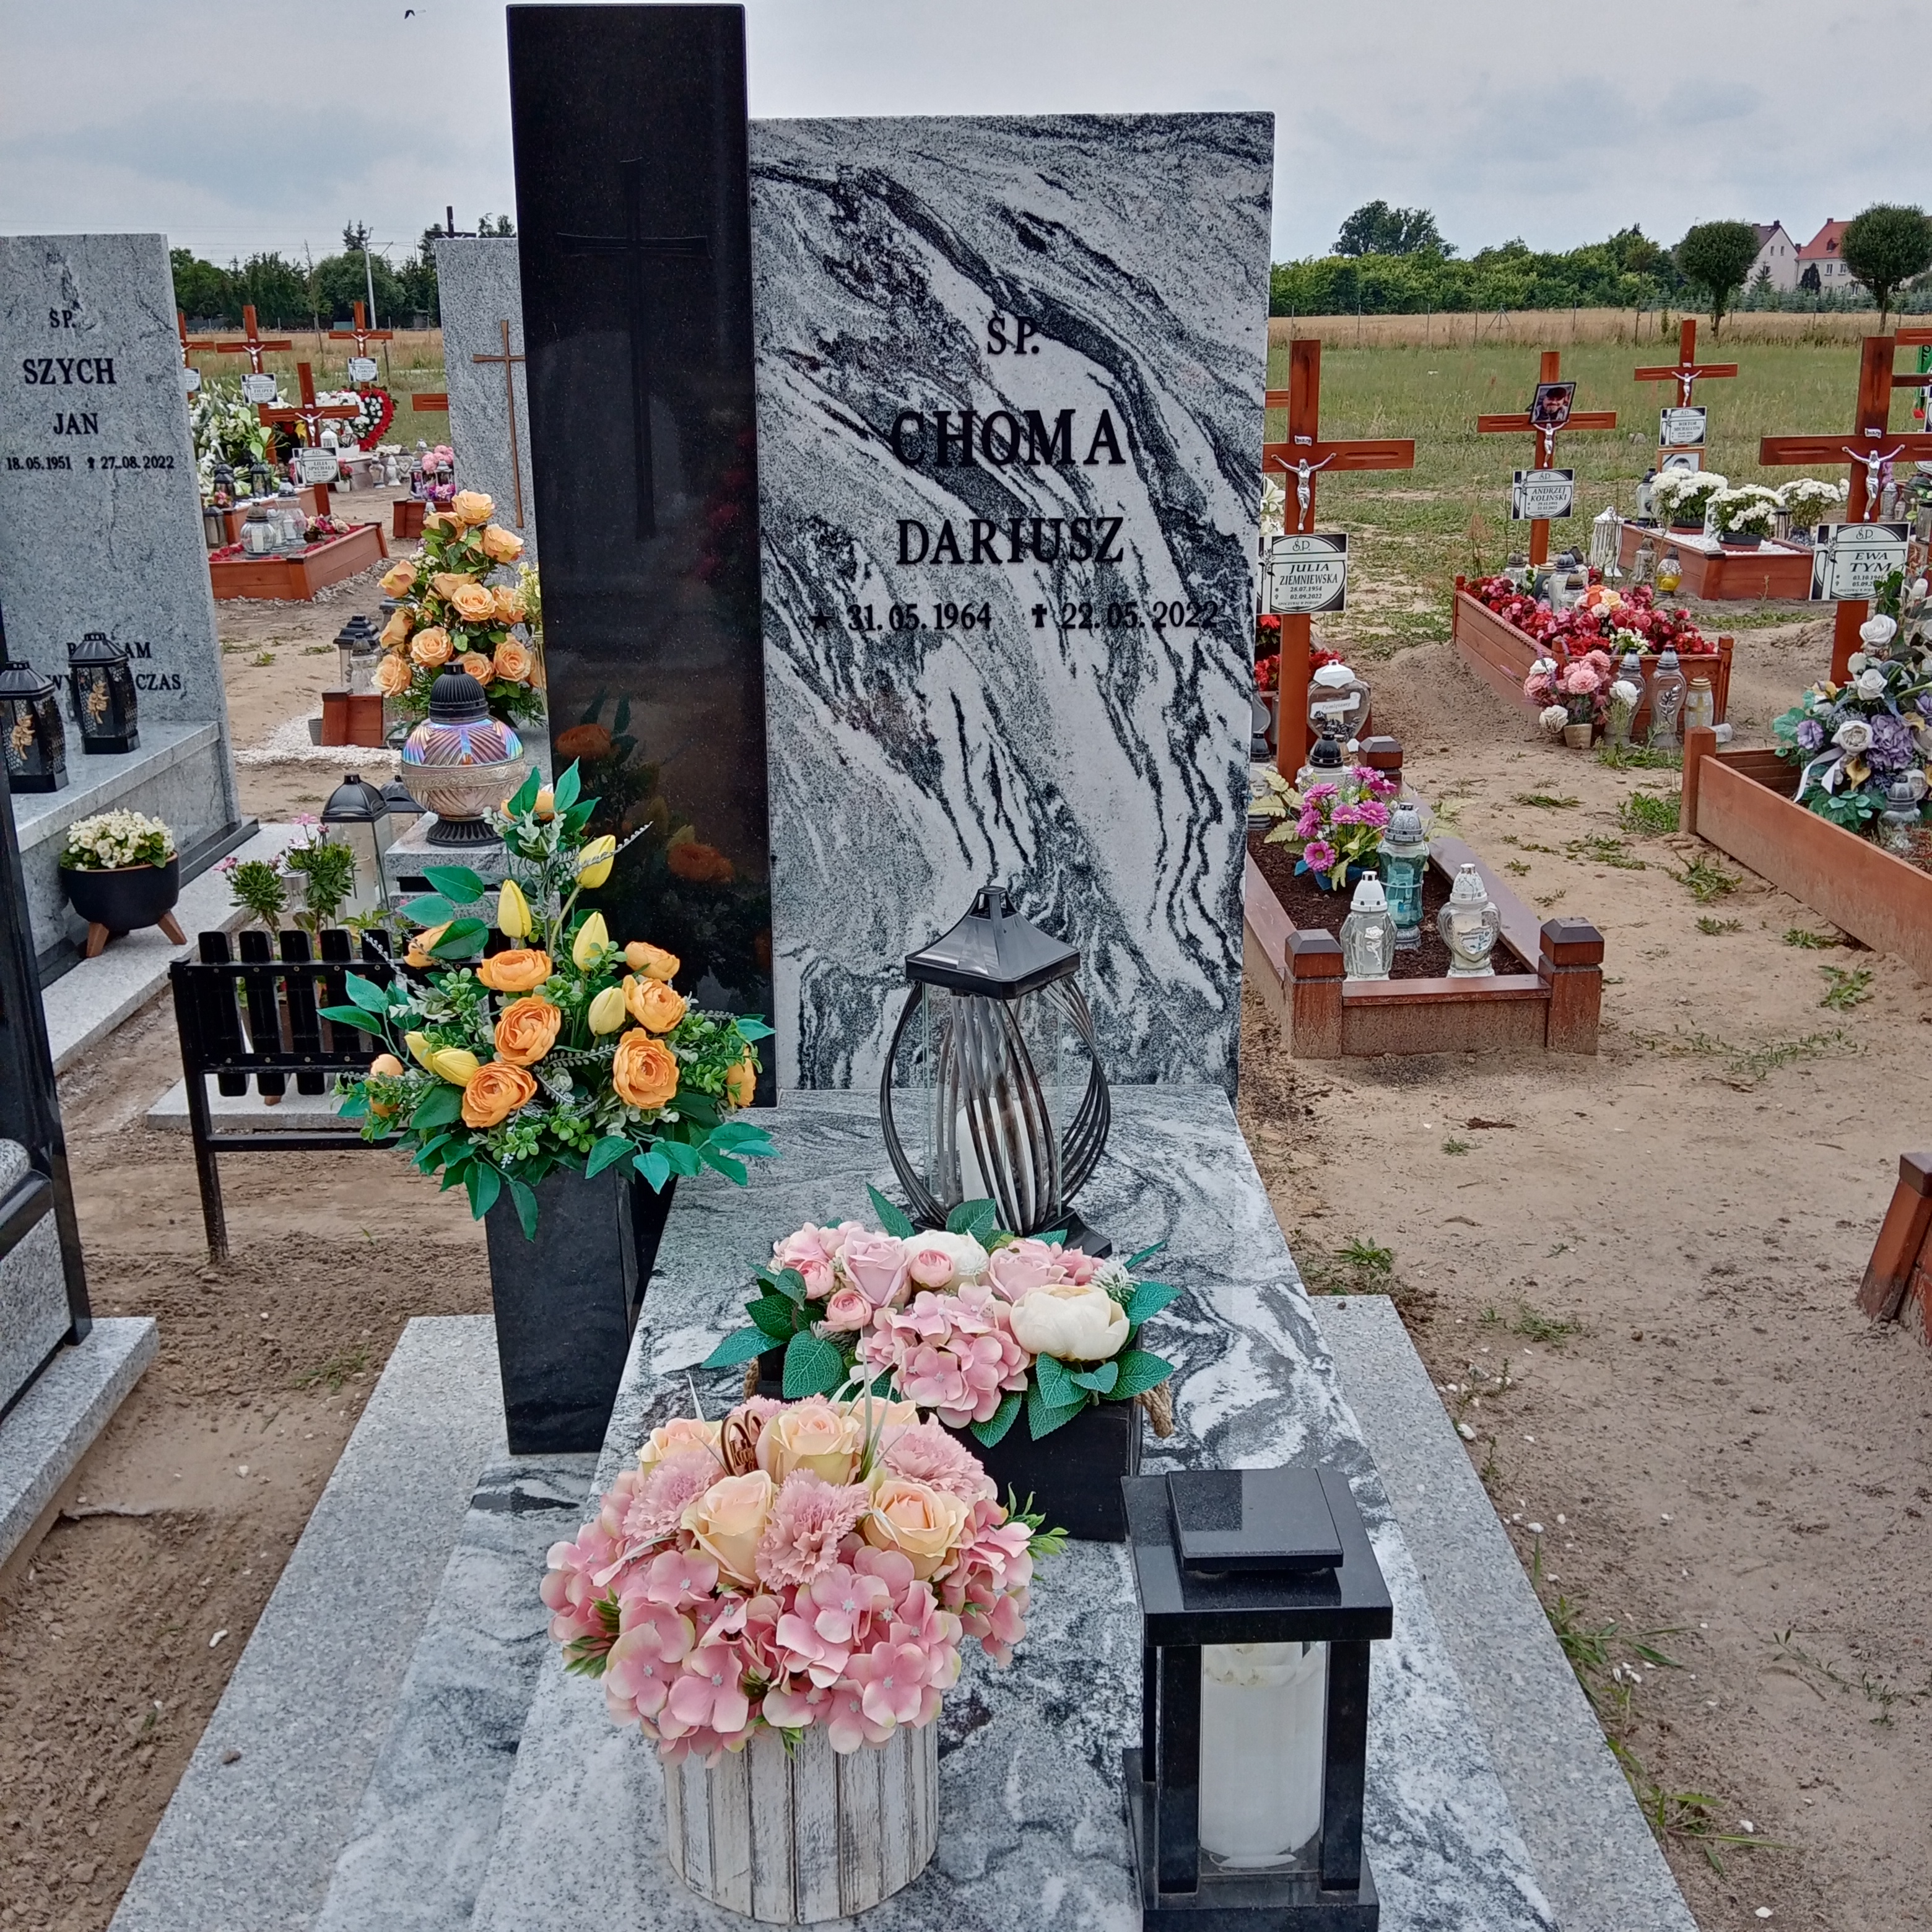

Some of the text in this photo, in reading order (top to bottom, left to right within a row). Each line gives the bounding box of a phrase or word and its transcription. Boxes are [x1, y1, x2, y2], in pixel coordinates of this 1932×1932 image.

[23, 358, 116, 385] SZYCH
[53, 413, 99, 435] JAN
[891, 409, 1126, 467] CHOMA
[6, 456, 175, 471] 18.05.1951 27.08.2022
[1532, 487, 1565, 495] ANDRZEJ
[896, 516, 1125, 565] DARIUSZ
[1289, 563, 1329, 575] JULIA
[1850, 562, 1893, 572] TYM
[1279, 573, 1338, 586] ZIEMNIEWSKA
[847, 601, 1219, 631] 31.05.1964 22.05.2022
[136, 674, 181, 690] CZAS
